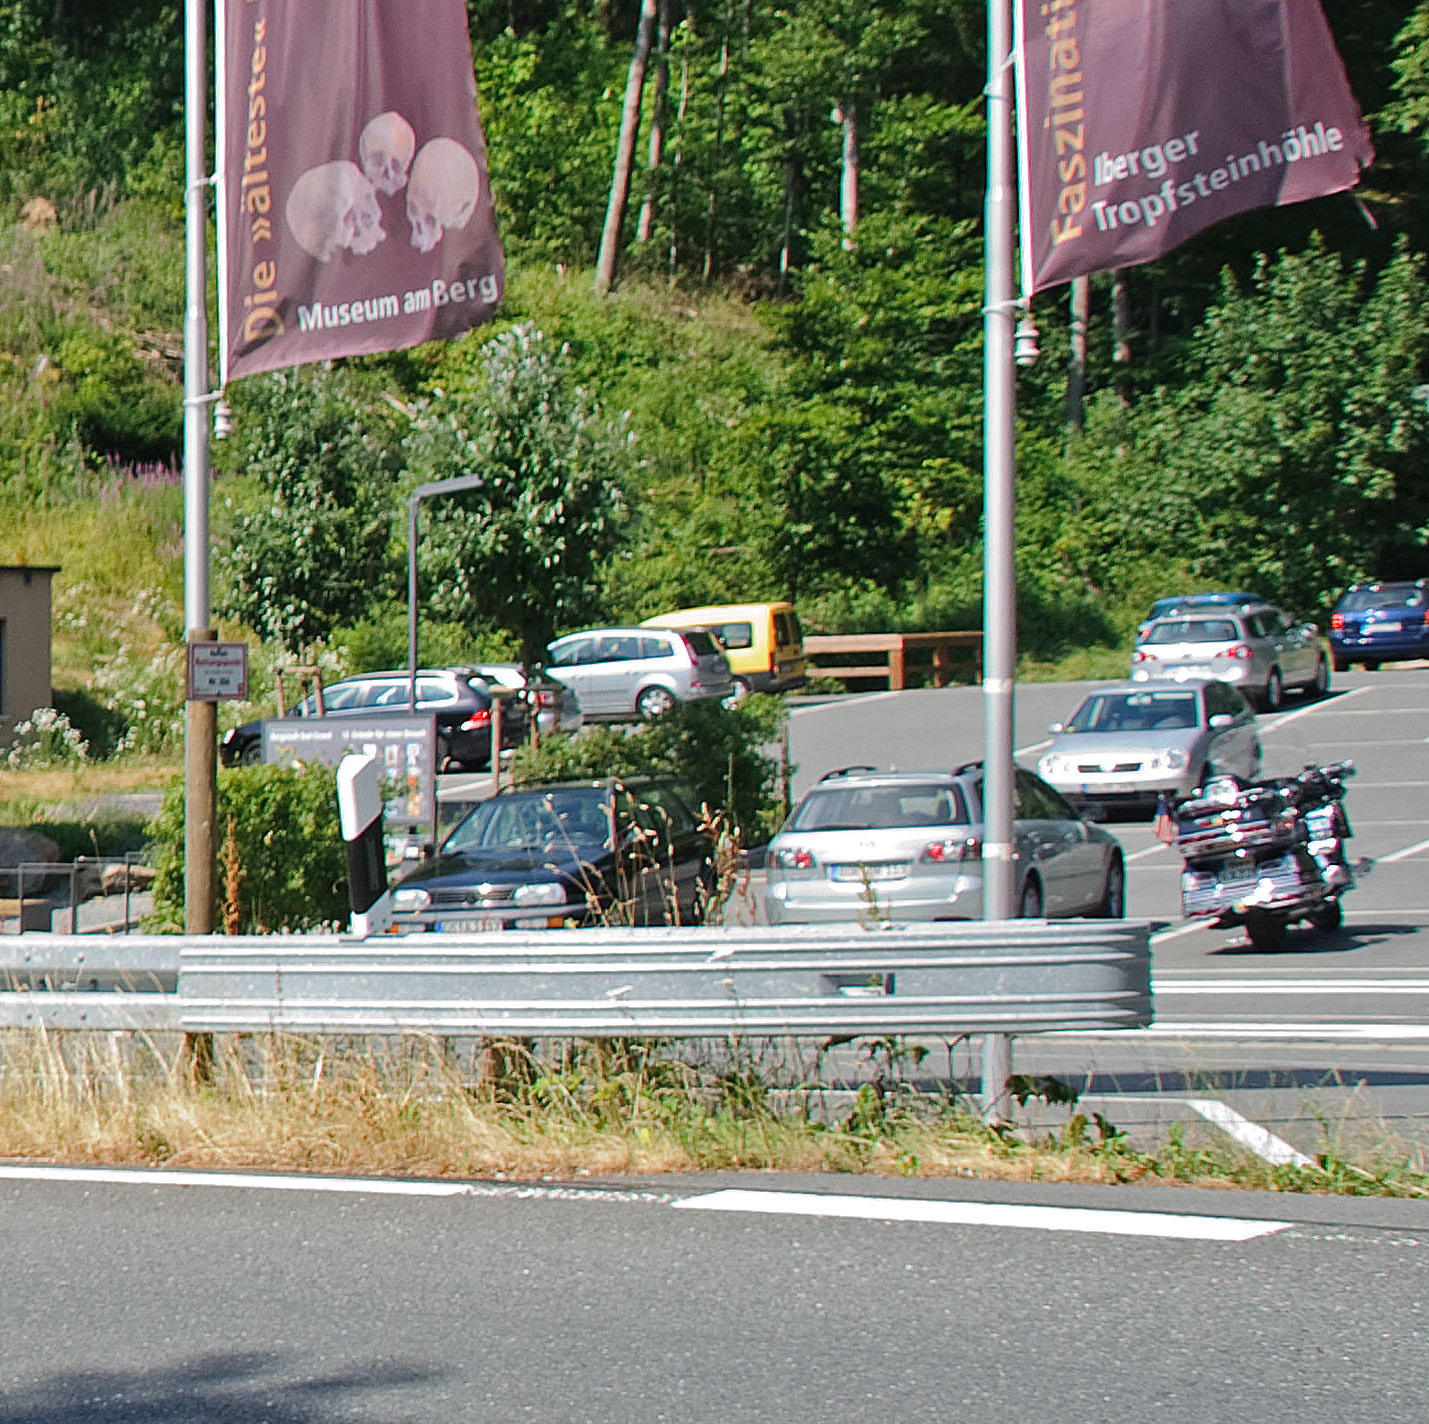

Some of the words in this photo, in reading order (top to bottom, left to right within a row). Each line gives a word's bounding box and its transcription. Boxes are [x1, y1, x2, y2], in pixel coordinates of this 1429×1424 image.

[1090, 121, 1344, 232] Tropfsteinhöhle
[1093, 129, 1201, 187] Iberger
[244, 260, 284, 342] Die
[297, 294, 399, 332] Museum
[403, 287, 430, 314] am
[431, 275, 498, 307] Berg
